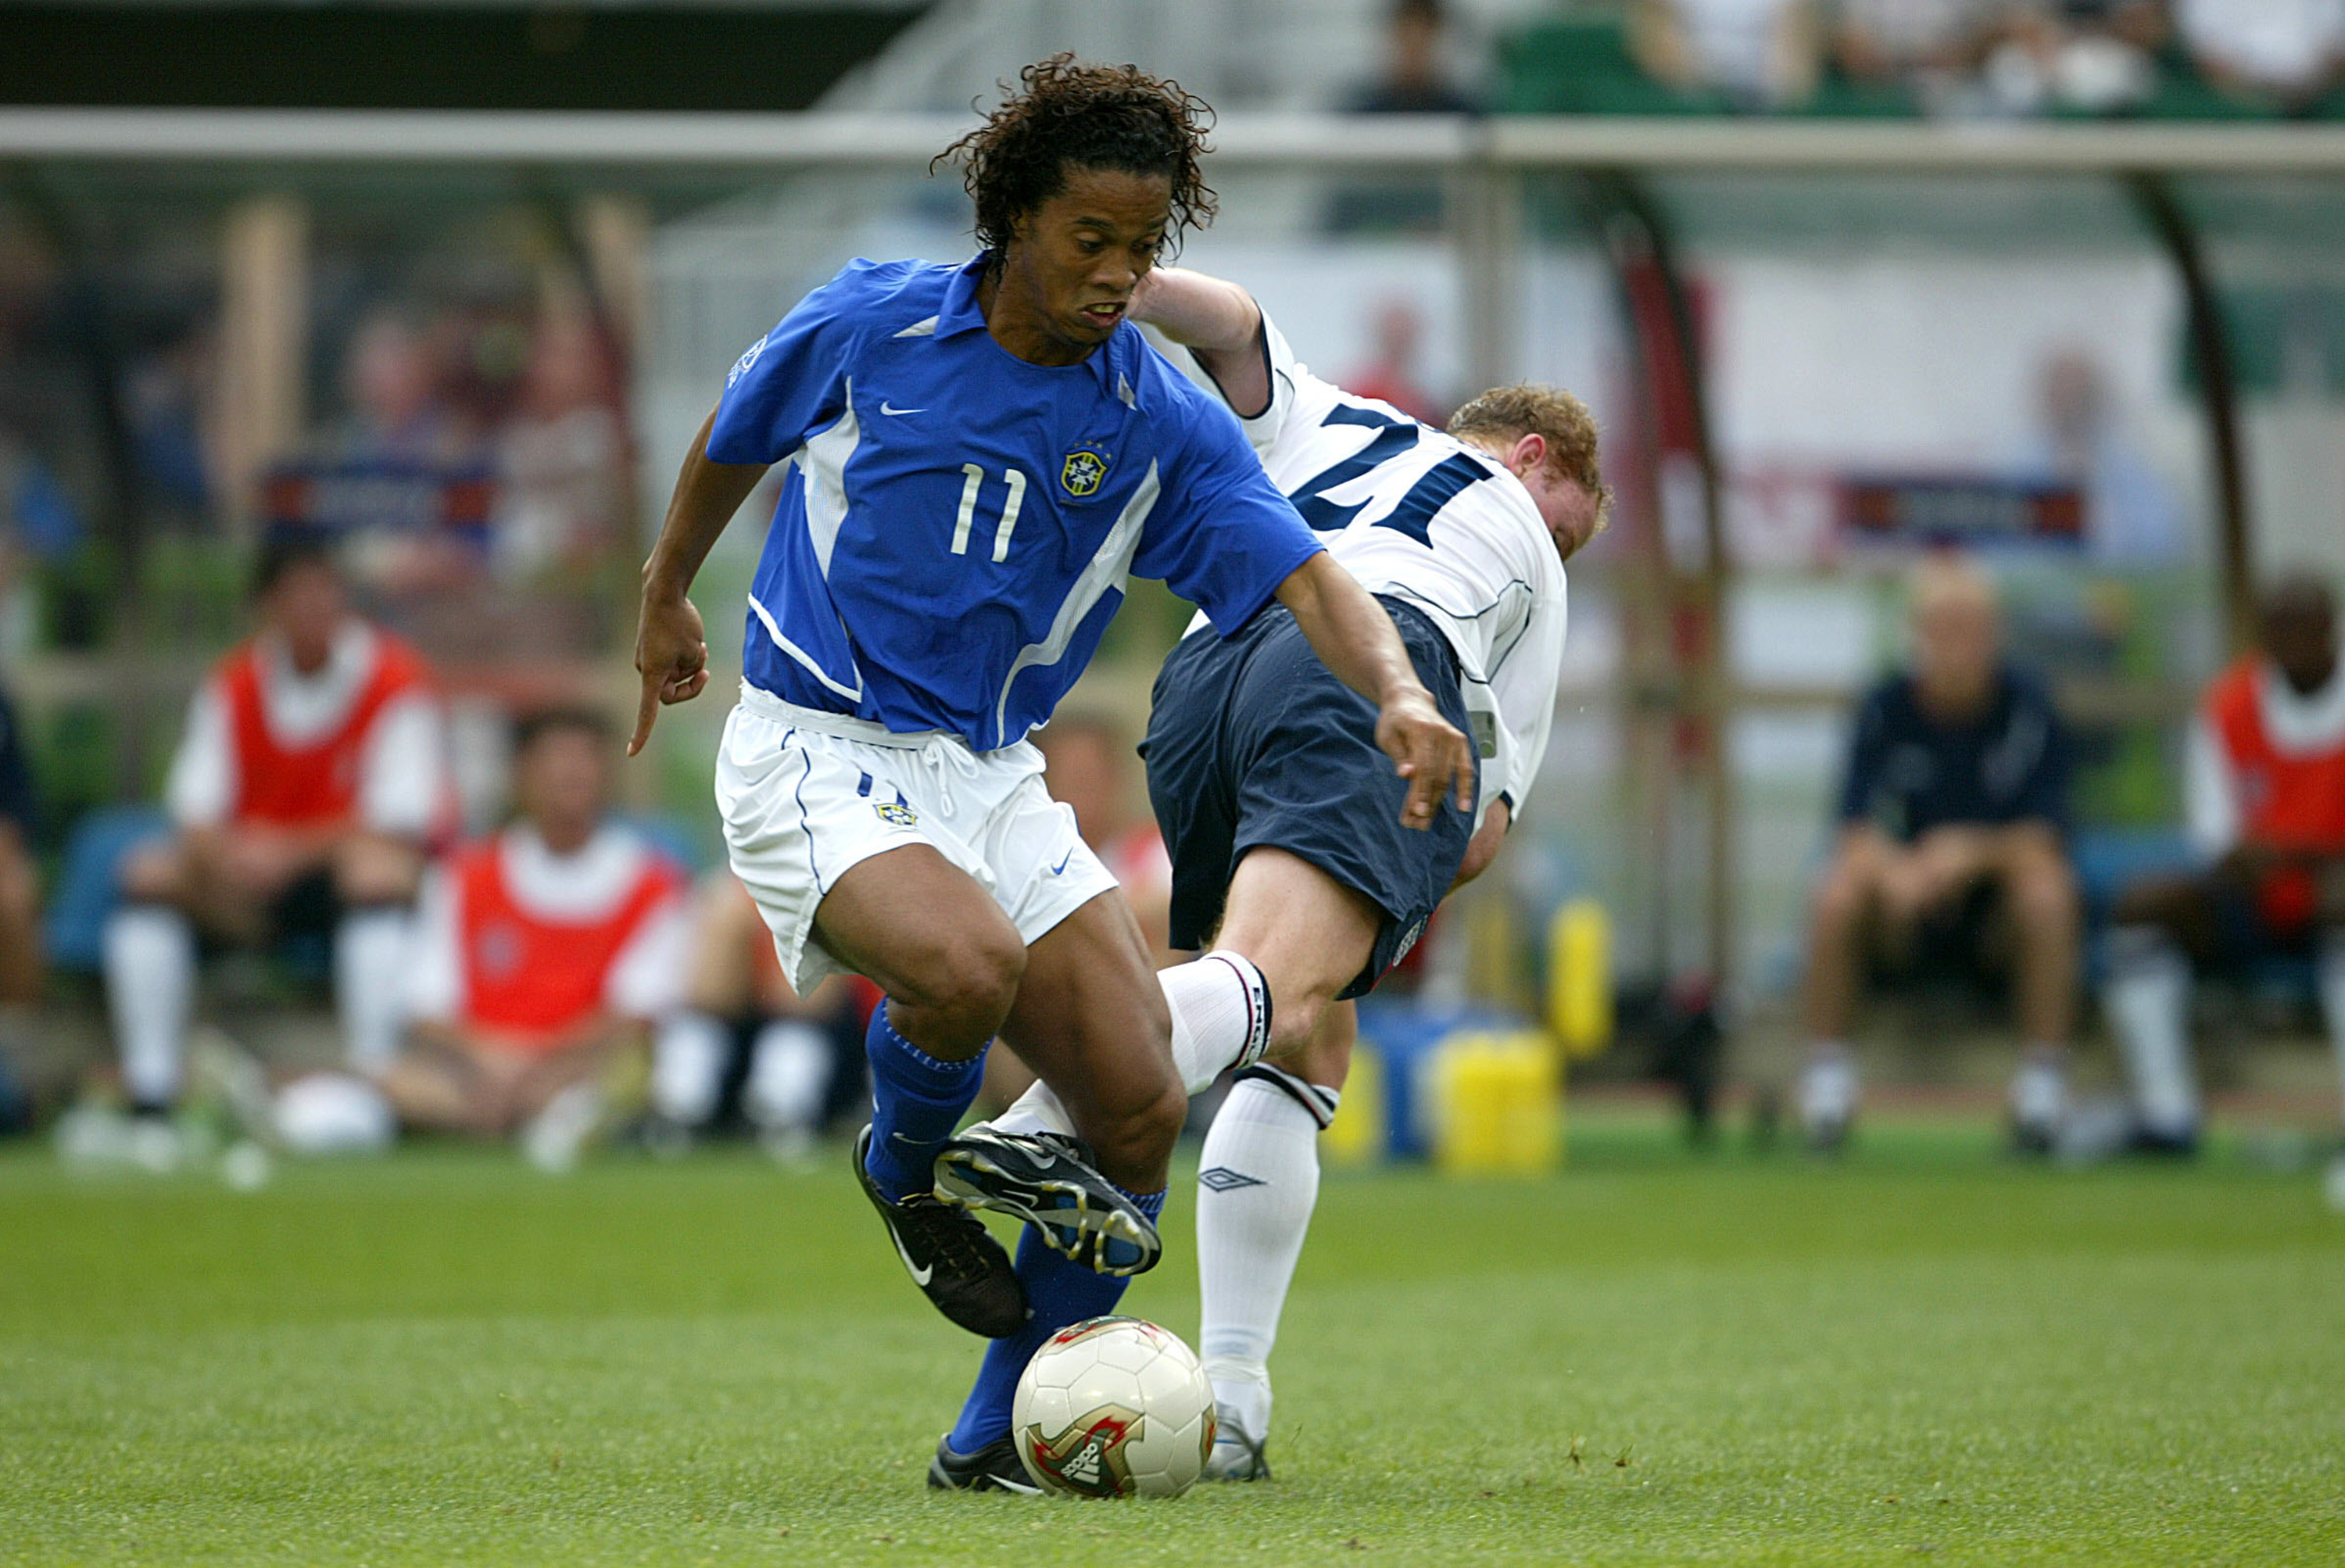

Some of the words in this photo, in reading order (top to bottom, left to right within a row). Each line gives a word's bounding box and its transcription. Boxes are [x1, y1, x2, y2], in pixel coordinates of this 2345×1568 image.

[951, 463, 1026, 563] 11
[1288, 403, 1494, 550] 21
[1061, 1442, 1098, 1477] adidas
